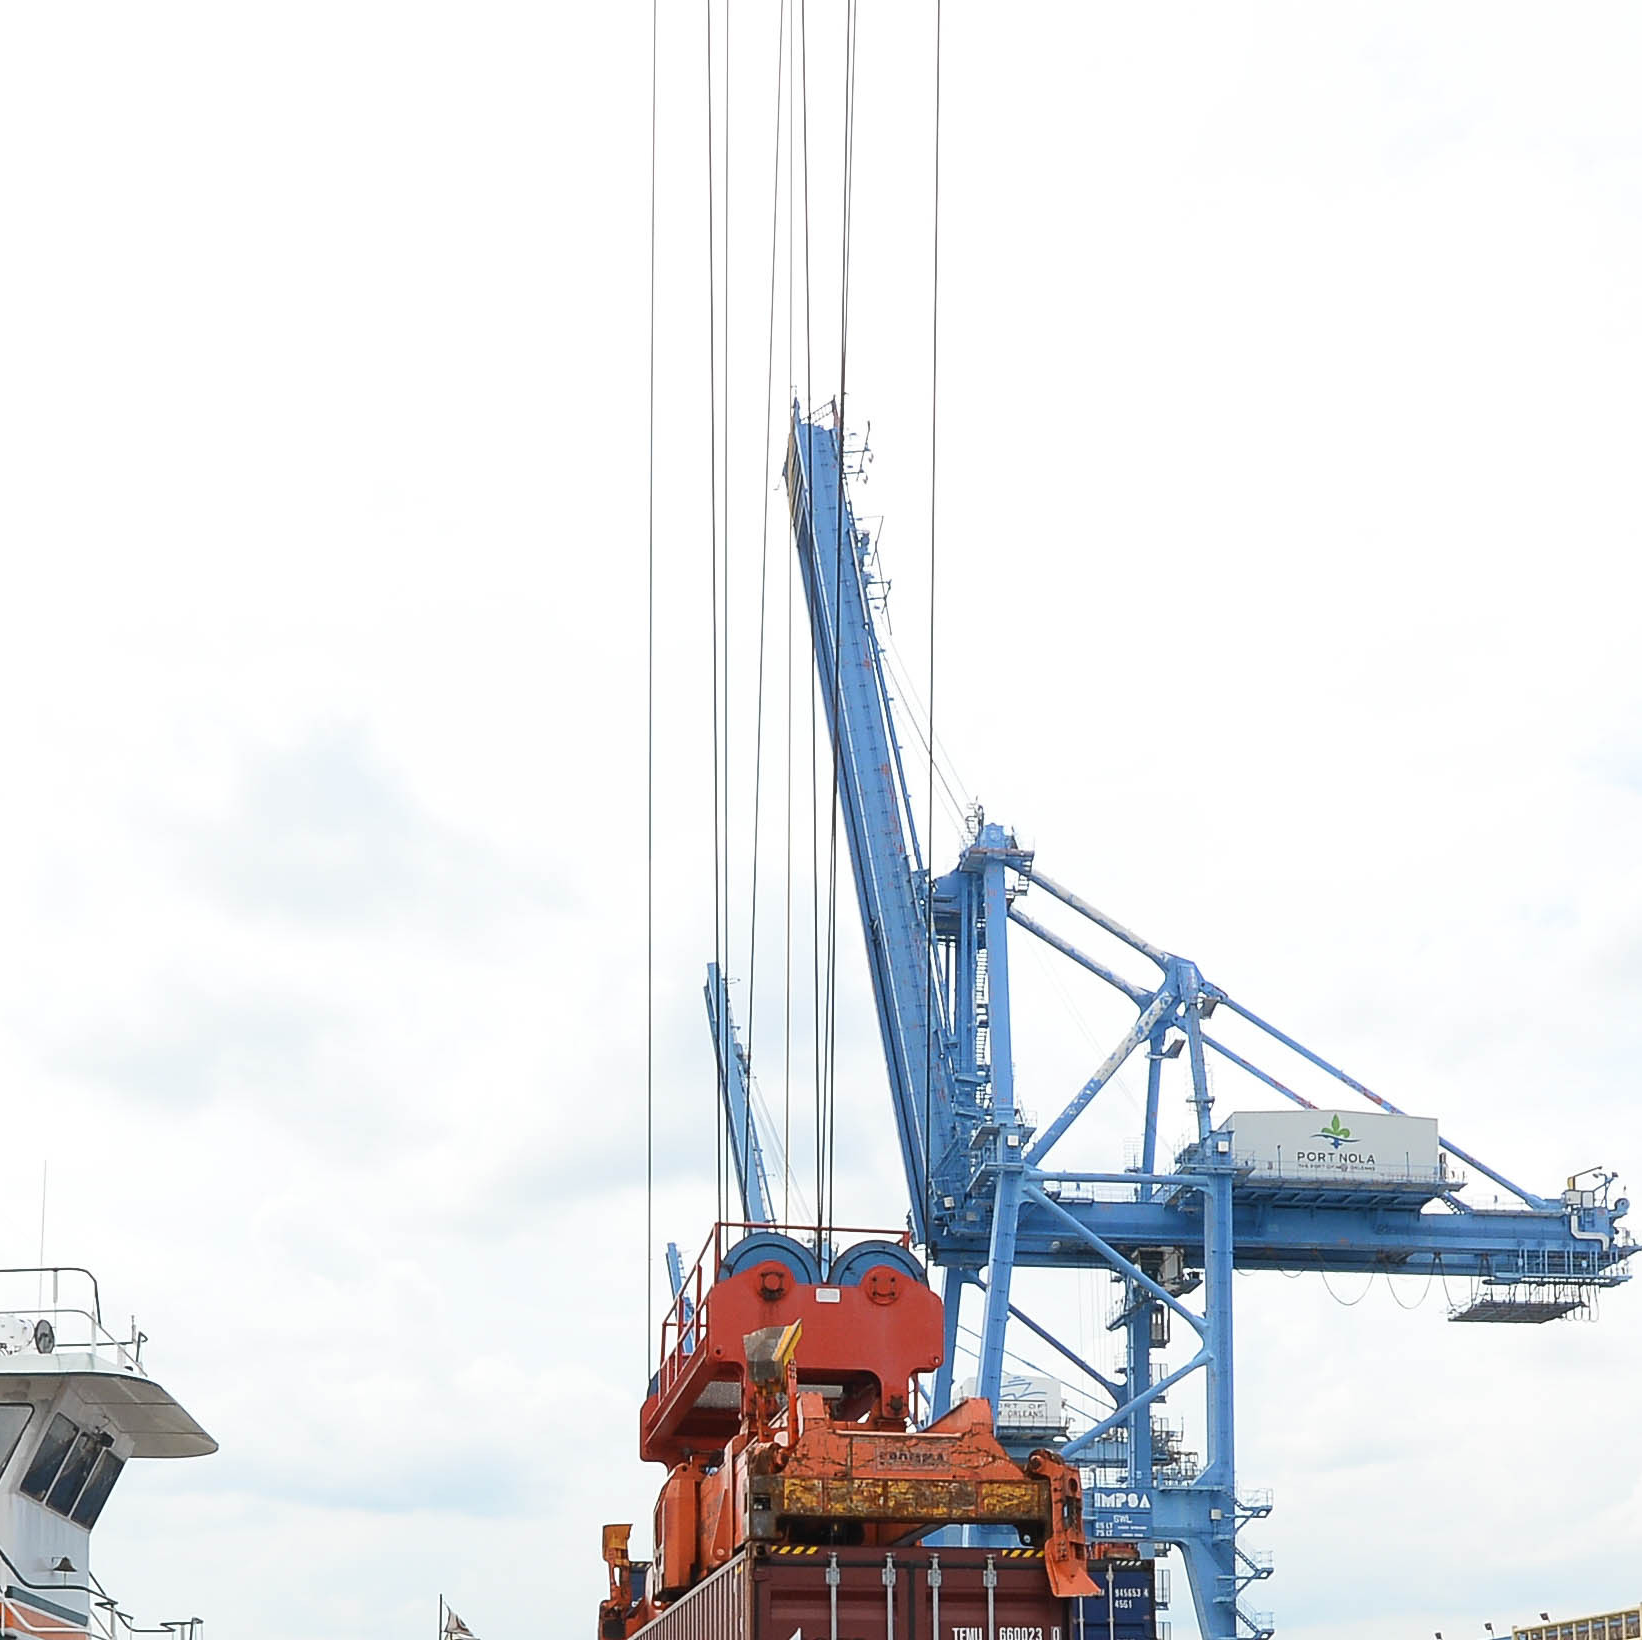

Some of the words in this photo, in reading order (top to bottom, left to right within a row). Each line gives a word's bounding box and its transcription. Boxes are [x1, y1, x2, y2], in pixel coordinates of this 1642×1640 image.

[1297, 1151, 1335, 1162] PORT
[1339, 1153, 1375, 1164] NOLA
[1093, 1492, 1151, 1508] IMPSA
